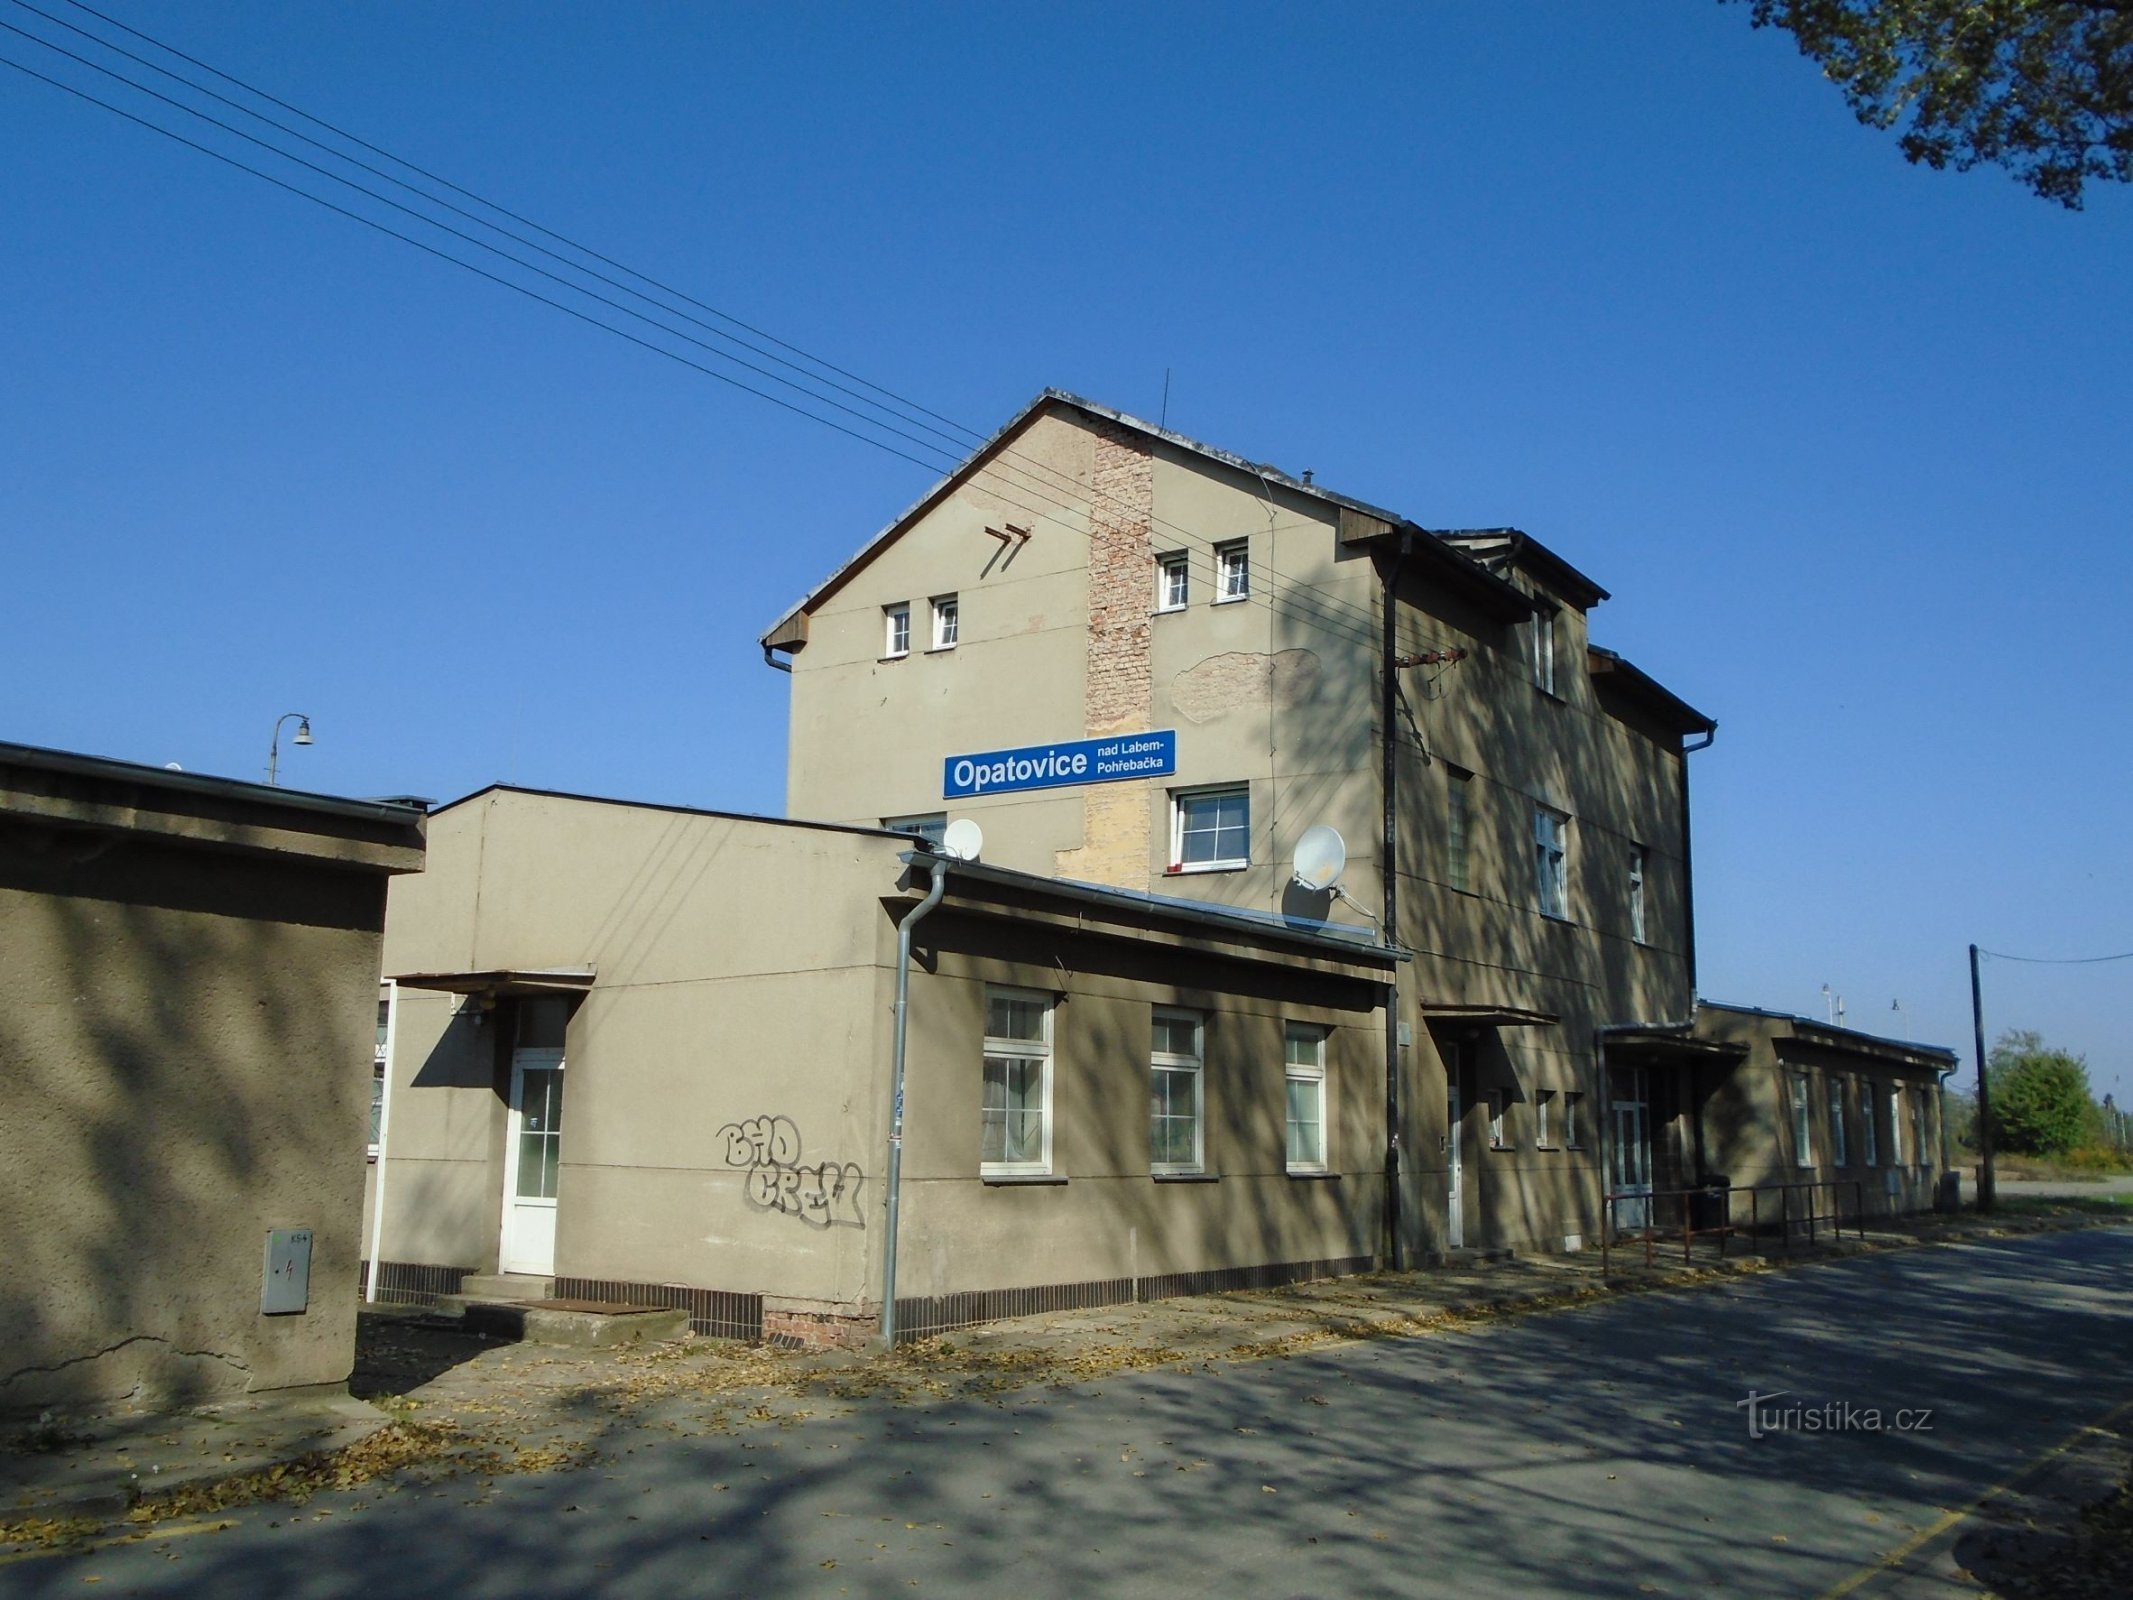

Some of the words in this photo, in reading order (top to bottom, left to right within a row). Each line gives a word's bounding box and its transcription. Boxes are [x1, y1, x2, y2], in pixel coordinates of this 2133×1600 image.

[1097, 743, 1118, 757] nad
[1122, 741, 1164, 755] Labem-
[954, 750, 1088, 791] Opatovice
[1097, 757, 1163, 774] Pohřebačka
